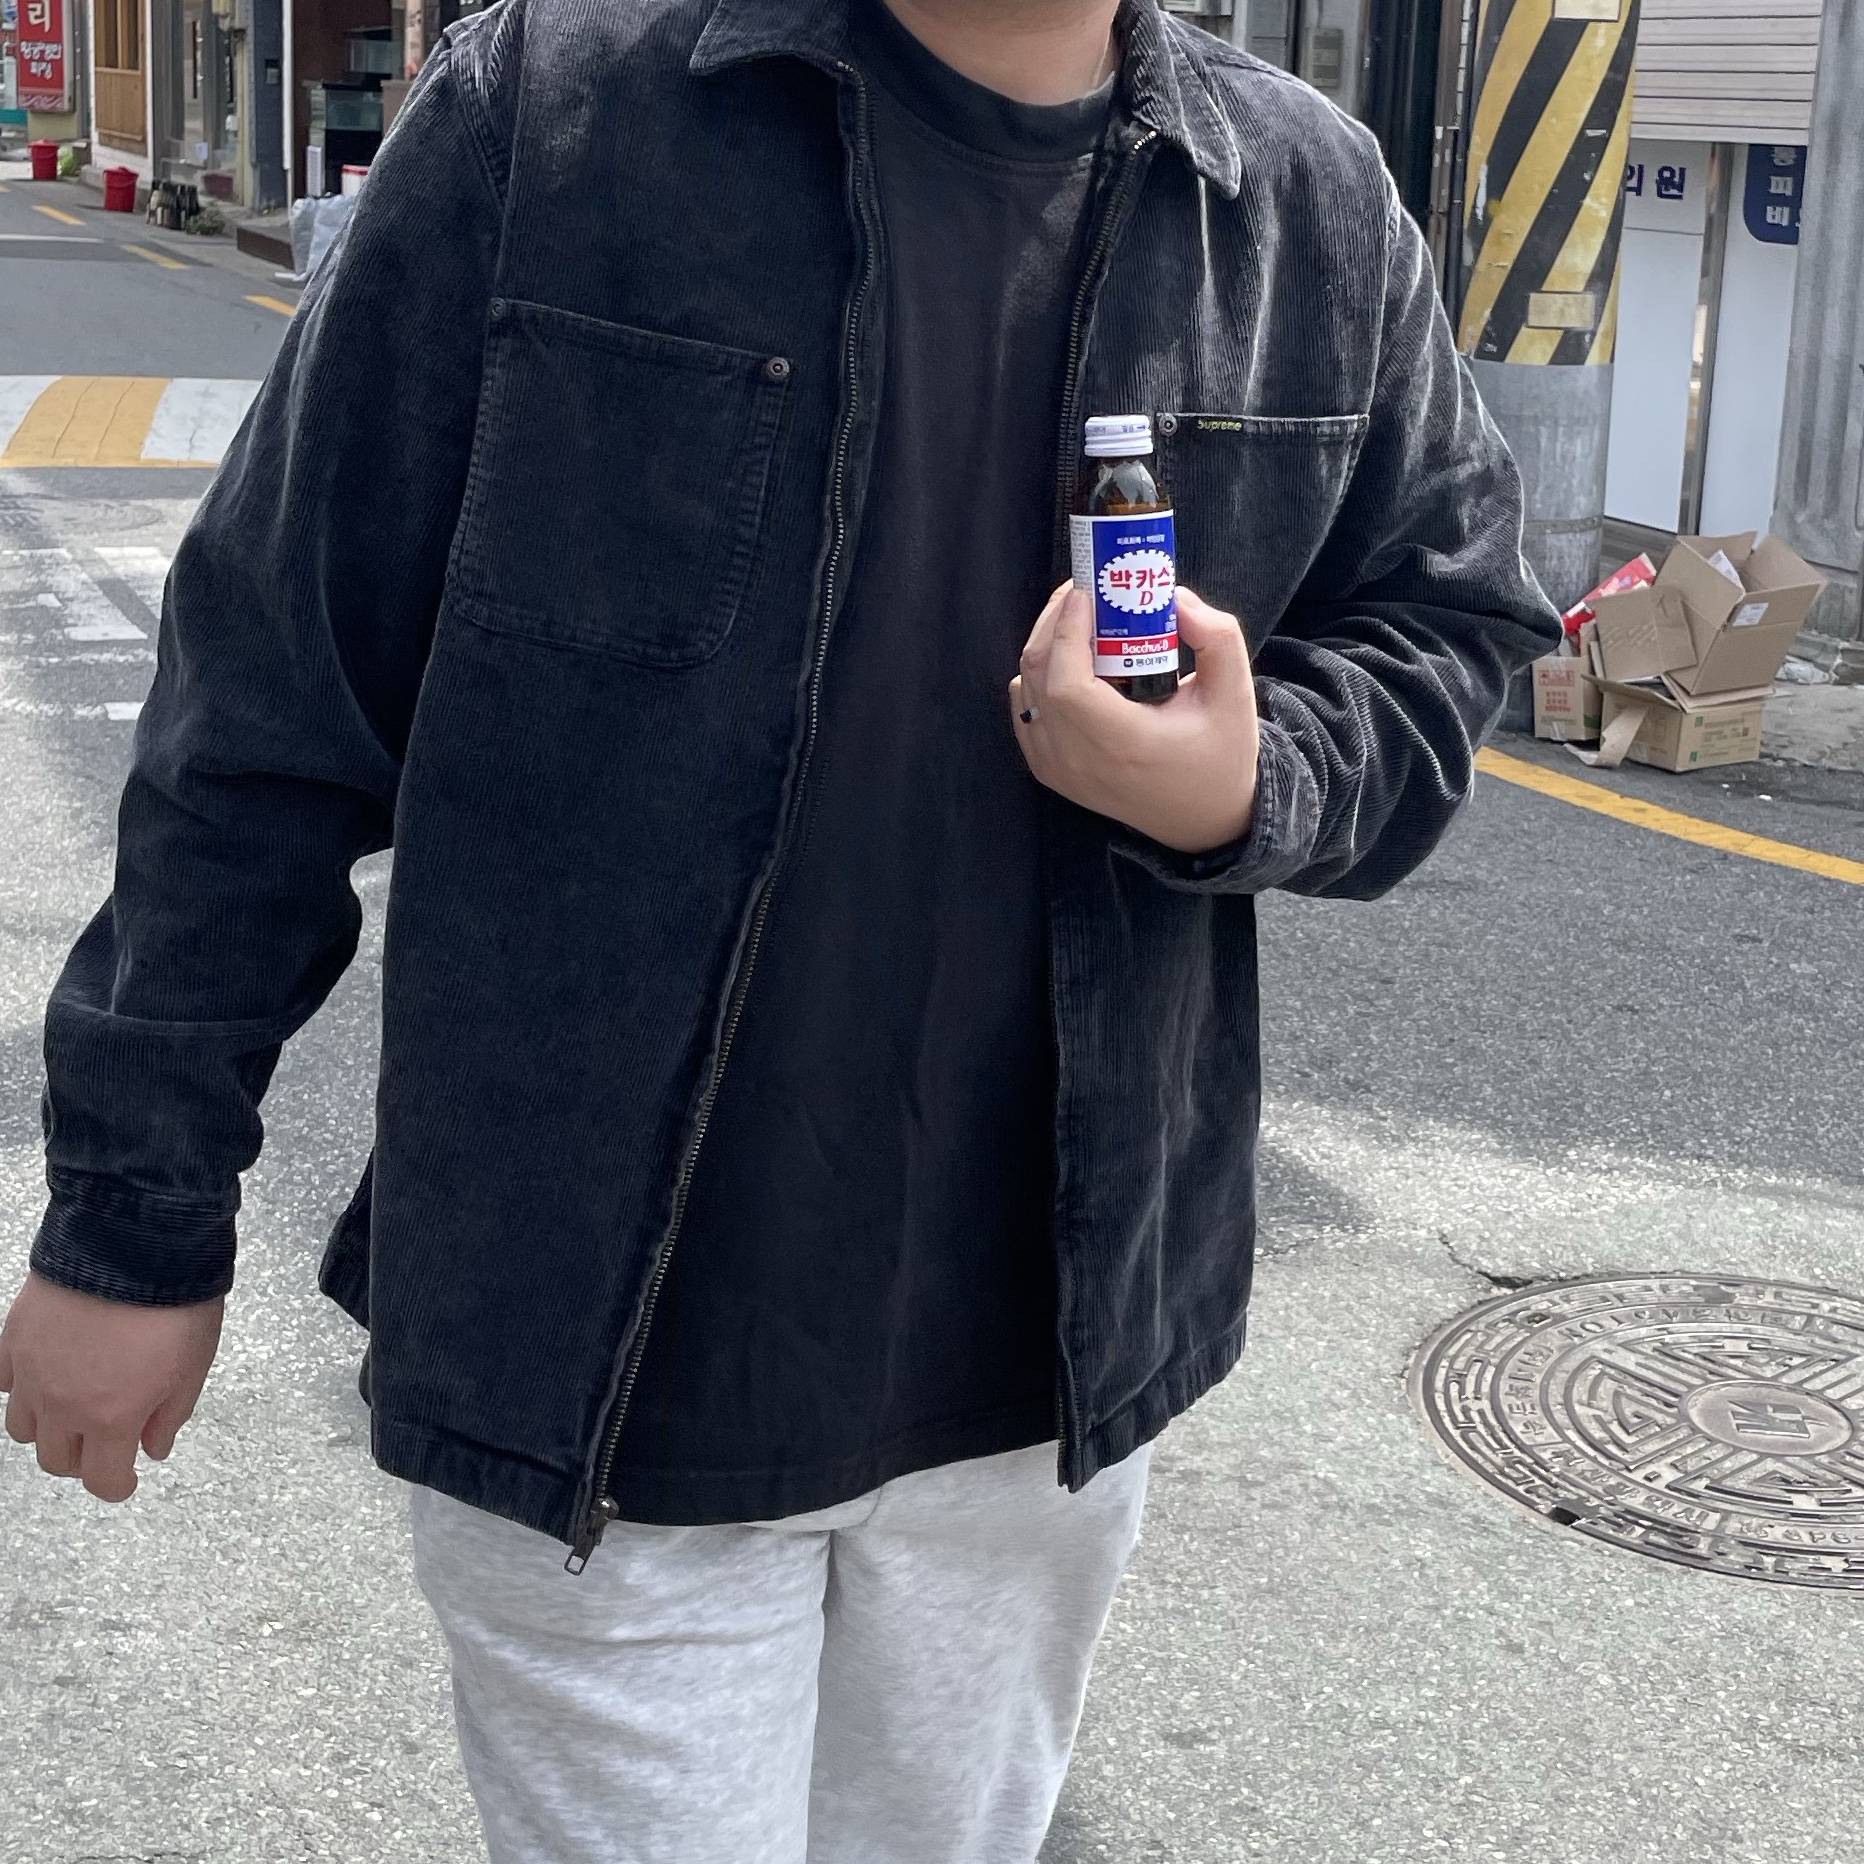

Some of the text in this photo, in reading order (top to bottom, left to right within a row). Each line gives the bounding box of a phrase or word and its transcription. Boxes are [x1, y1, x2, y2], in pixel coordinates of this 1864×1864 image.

[27, 0, 51, 33] 리
[1197, 419, 1243, 432] Supreme
[1109, 565, 1171, 591] 박카스
[1138, 590, 1154, 606] D
